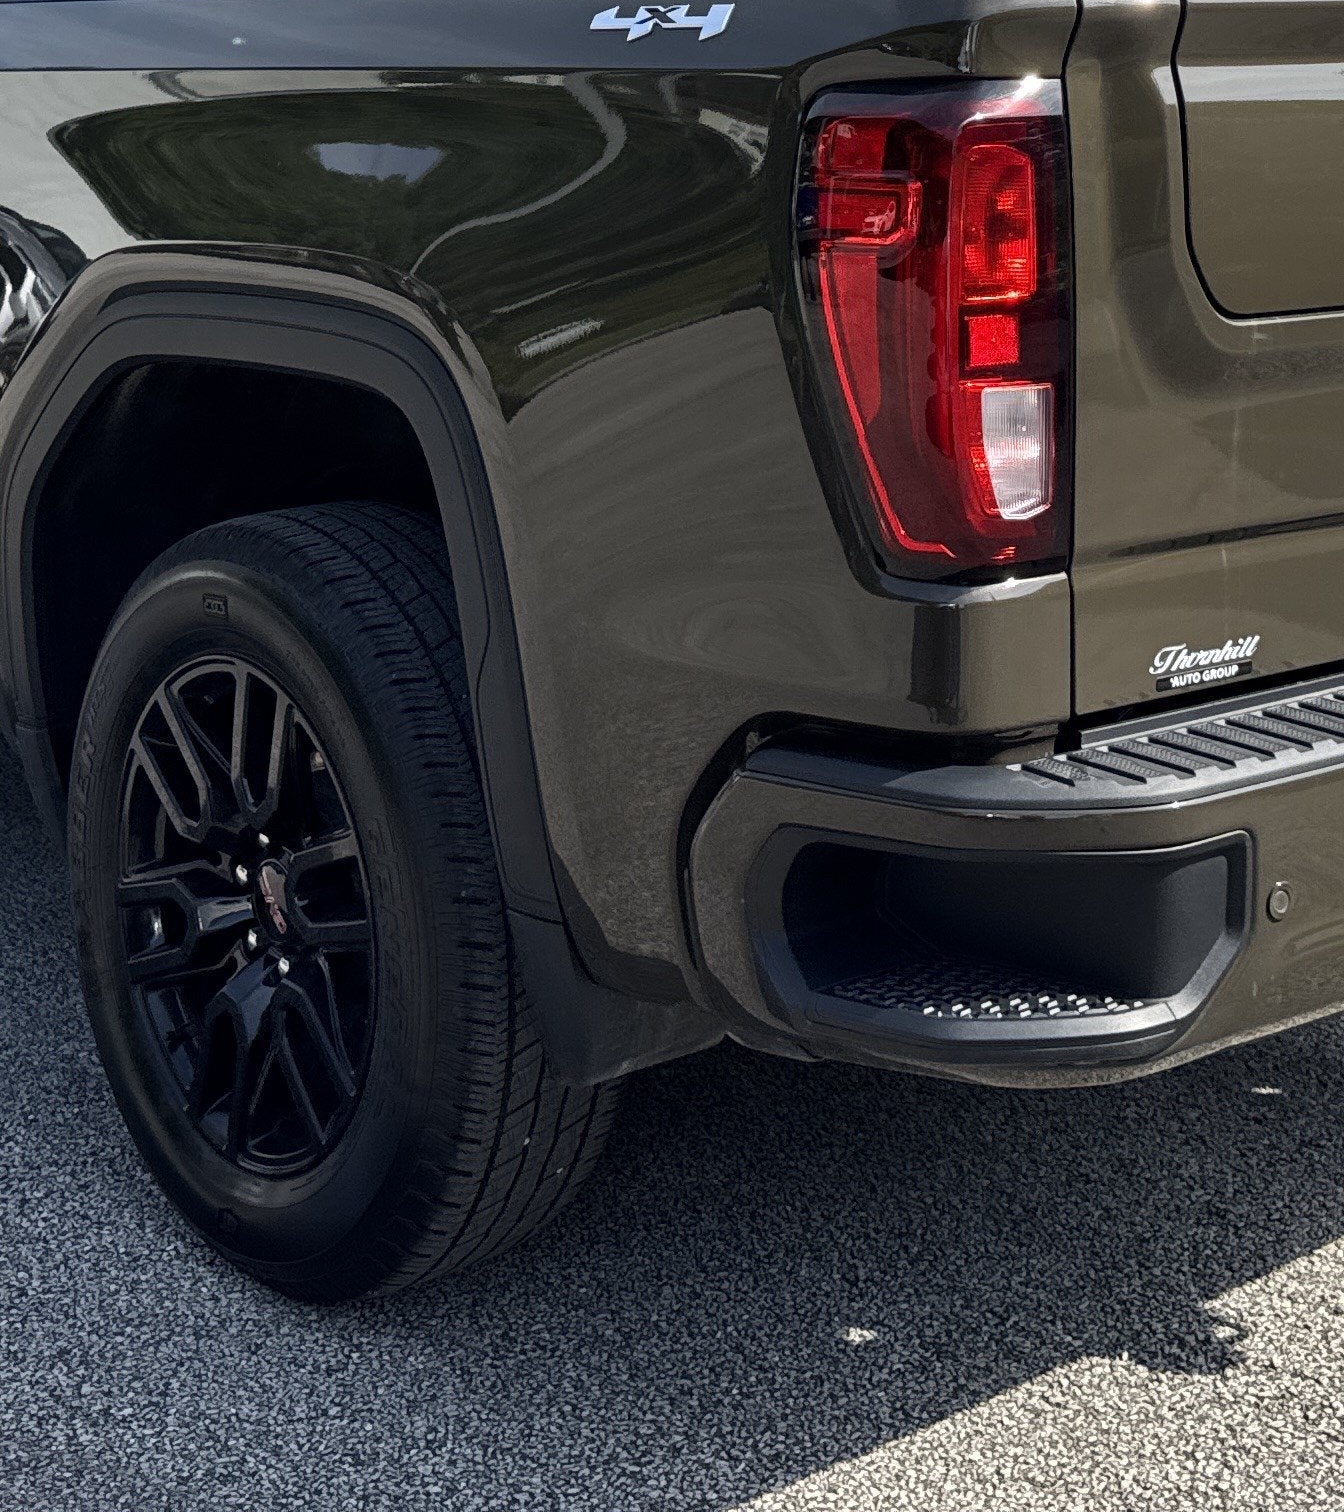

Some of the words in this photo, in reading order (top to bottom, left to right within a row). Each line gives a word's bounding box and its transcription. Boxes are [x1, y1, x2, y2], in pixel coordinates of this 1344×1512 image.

[1148, 635, 1261, 675] Thornhill
[1169, 670, 1201, 688] AUTO
[1202, 664, 1239, 682] GROUP
